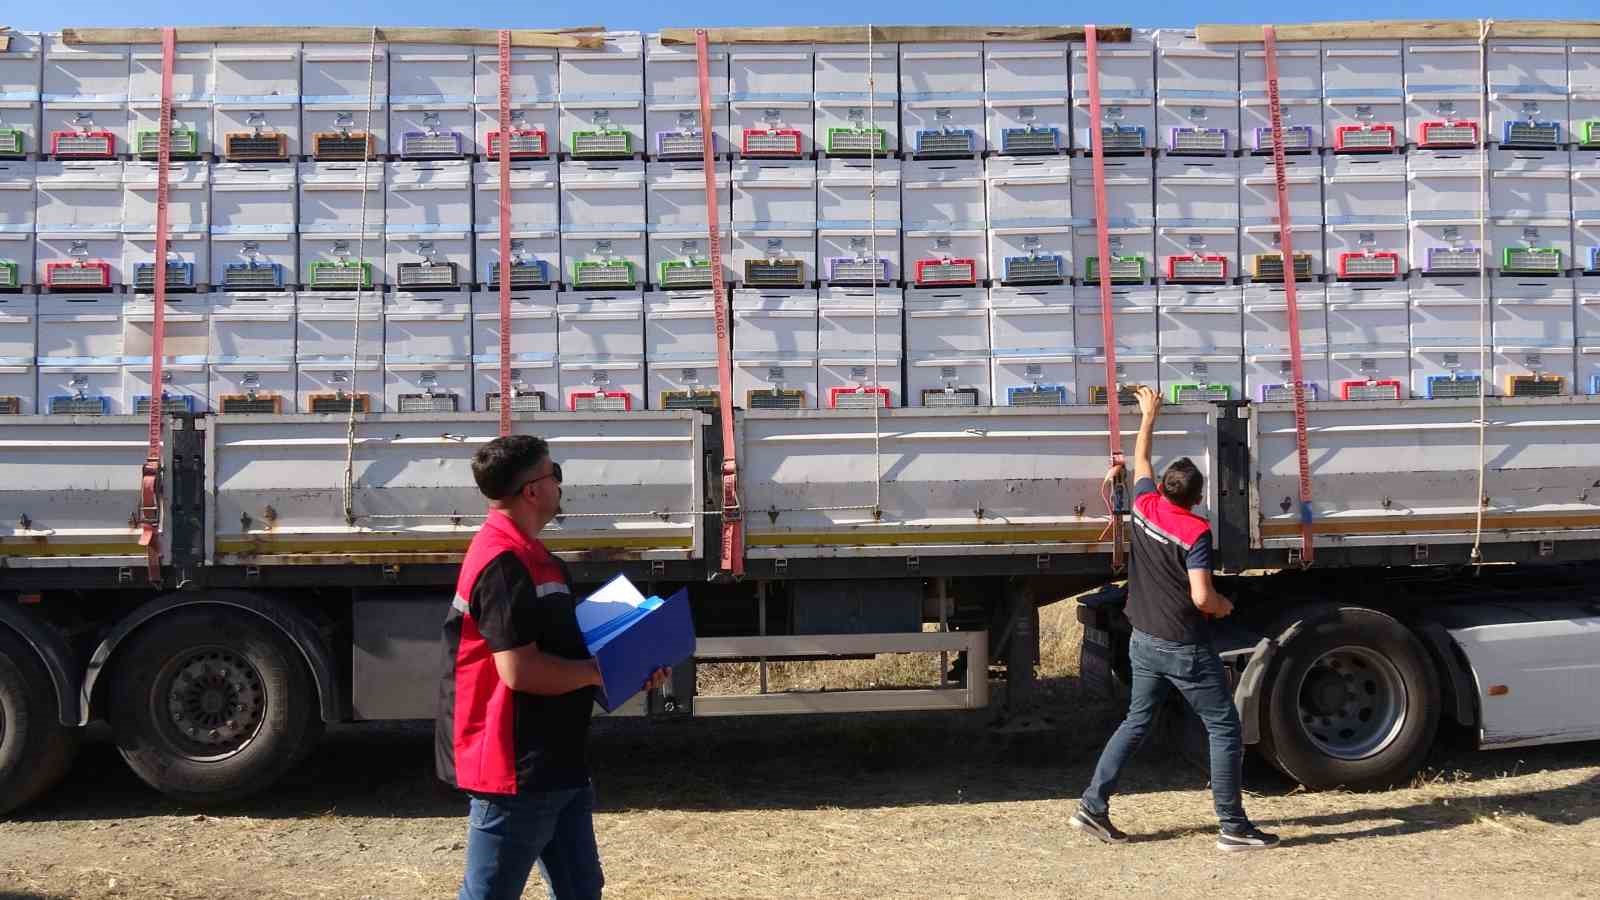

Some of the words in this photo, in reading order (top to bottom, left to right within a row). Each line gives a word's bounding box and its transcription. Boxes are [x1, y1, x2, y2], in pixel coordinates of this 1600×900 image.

[1269, 79, 1279, 113] CARGO
[1274, 140, 1282, 151] BY
[1276, 154, 1286, 191] OWNED
[709, 225, 720, 263] OWNED
[715, 305, 725, 339] CARGO
[1294, 381, 1305, 415] CARGO
[1298, 443, 1307, 456] BY
[1300, 457, 1310, 496] OWNED
